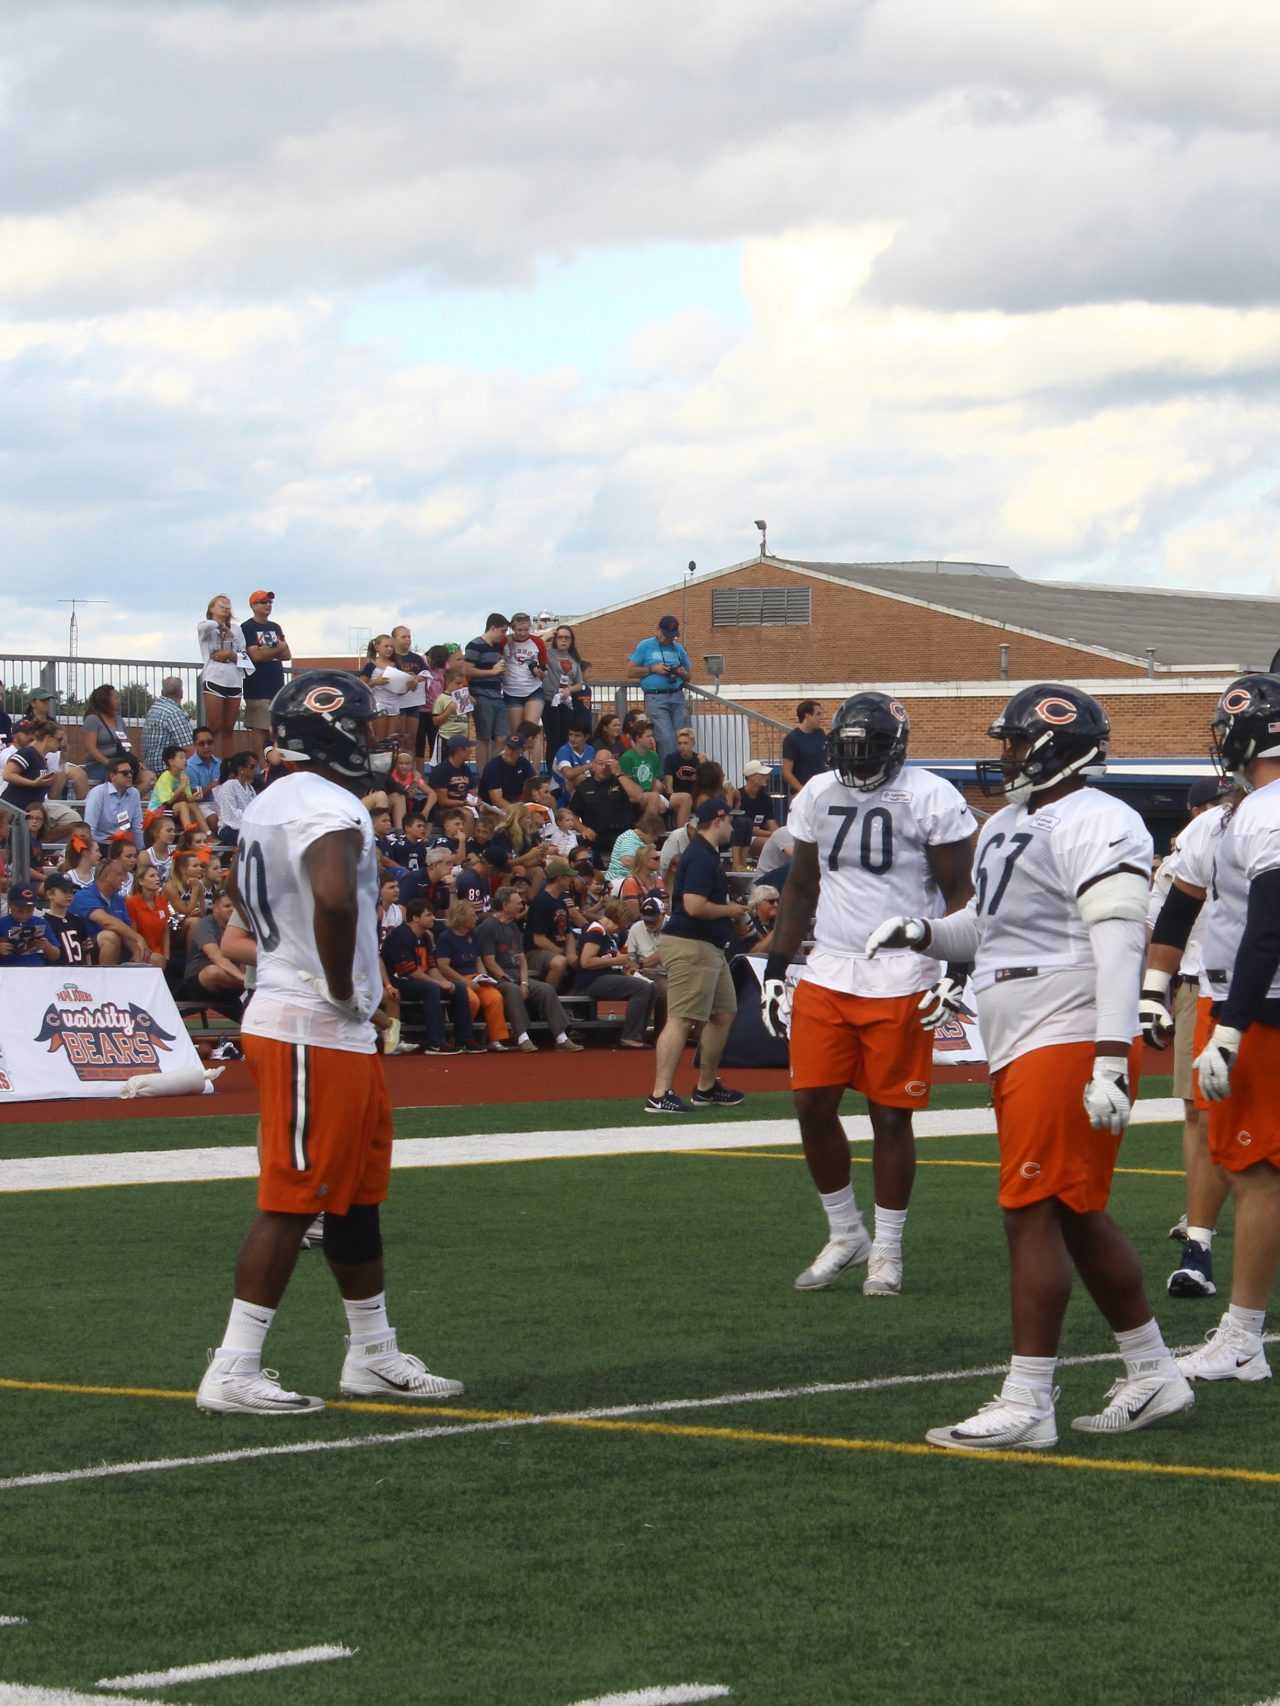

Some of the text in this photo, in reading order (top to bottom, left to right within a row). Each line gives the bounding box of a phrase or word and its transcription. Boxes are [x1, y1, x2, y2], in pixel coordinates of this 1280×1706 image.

[1036, 698, 1077, 724] C
[828, 805, 893, 875] 70
[976, 833, 1033, 916] 67
[61, 930, 82, 963] 15
[62, 1003, 135, 1035] varsity
[62, 1031, 157, 1065] BEARS
[1139, 1359, 1160, 1371] NIKE
